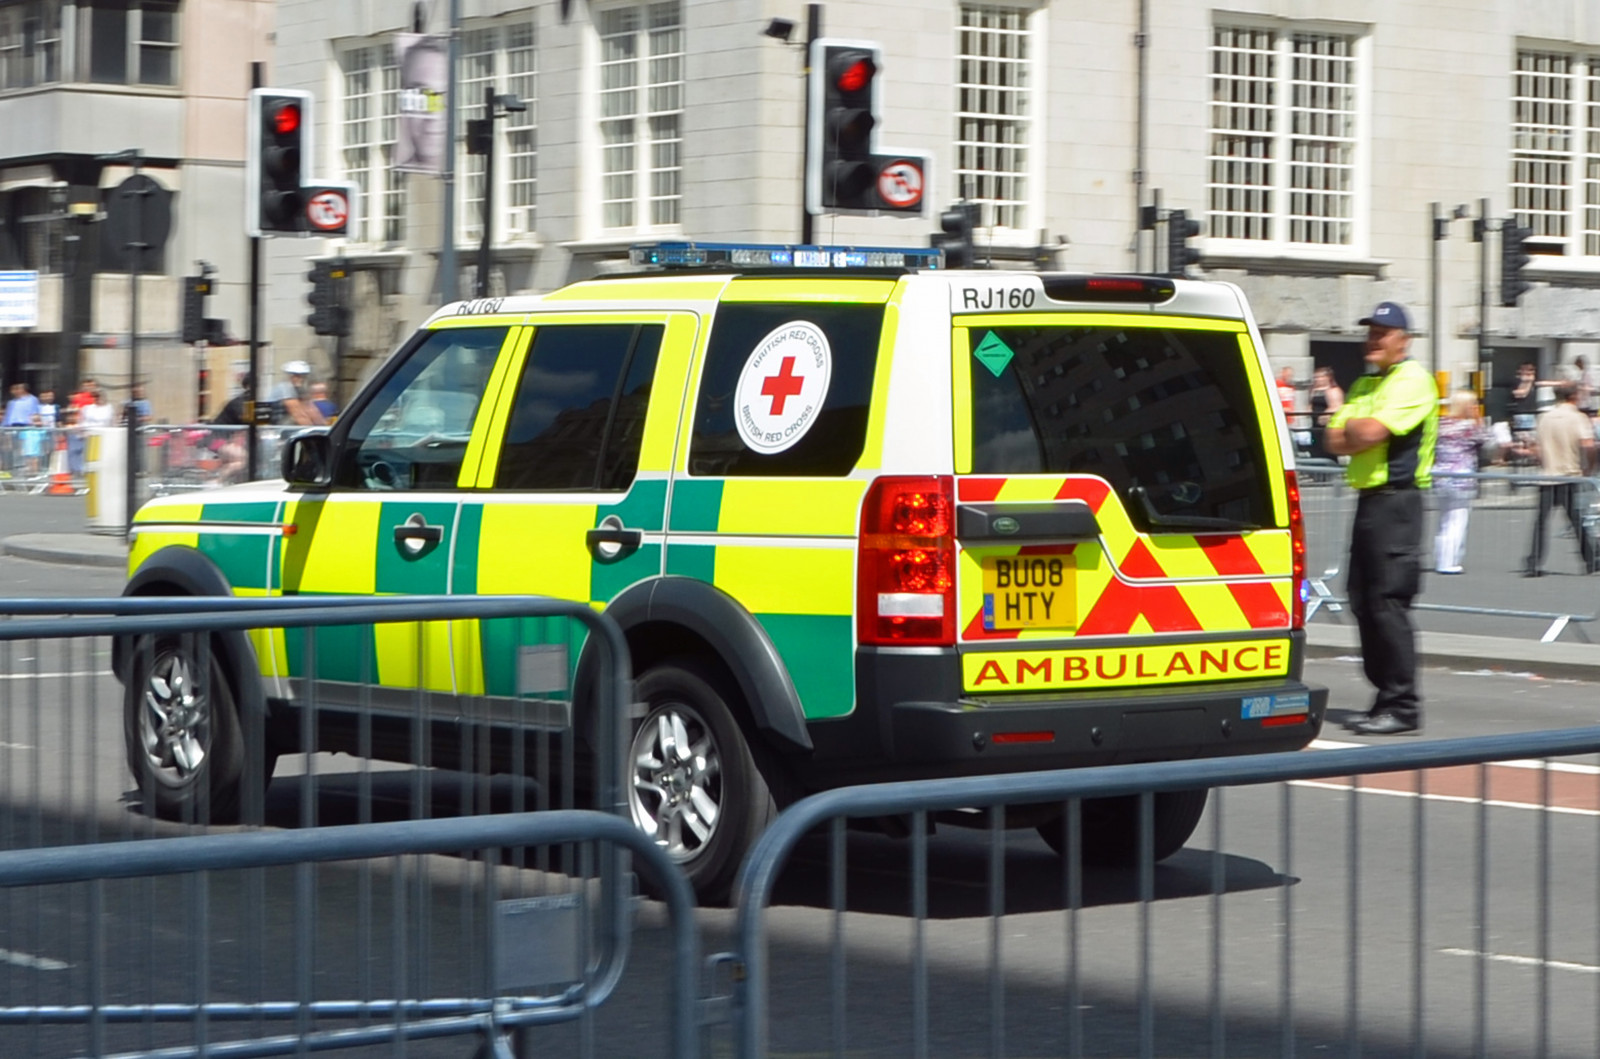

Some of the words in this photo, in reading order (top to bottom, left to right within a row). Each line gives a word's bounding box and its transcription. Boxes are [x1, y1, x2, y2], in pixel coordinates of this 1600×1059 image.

[962, 287, 1036, 309] RJ160
[753, 333, 787, 368] BRITISH
[788, 330, 807, 341] RED
[806, 335, 824, 369] CROSS
[742, 404, 764, 440] BRITISH
[764, 431, 783, 443] RED
[784, 404, 813, 438] CROSS
[995, 558, 1064, 588] BU08
[1005, 591, 1055, 621] HTY
[973, 645, 1282, 686] AMBULANCE
